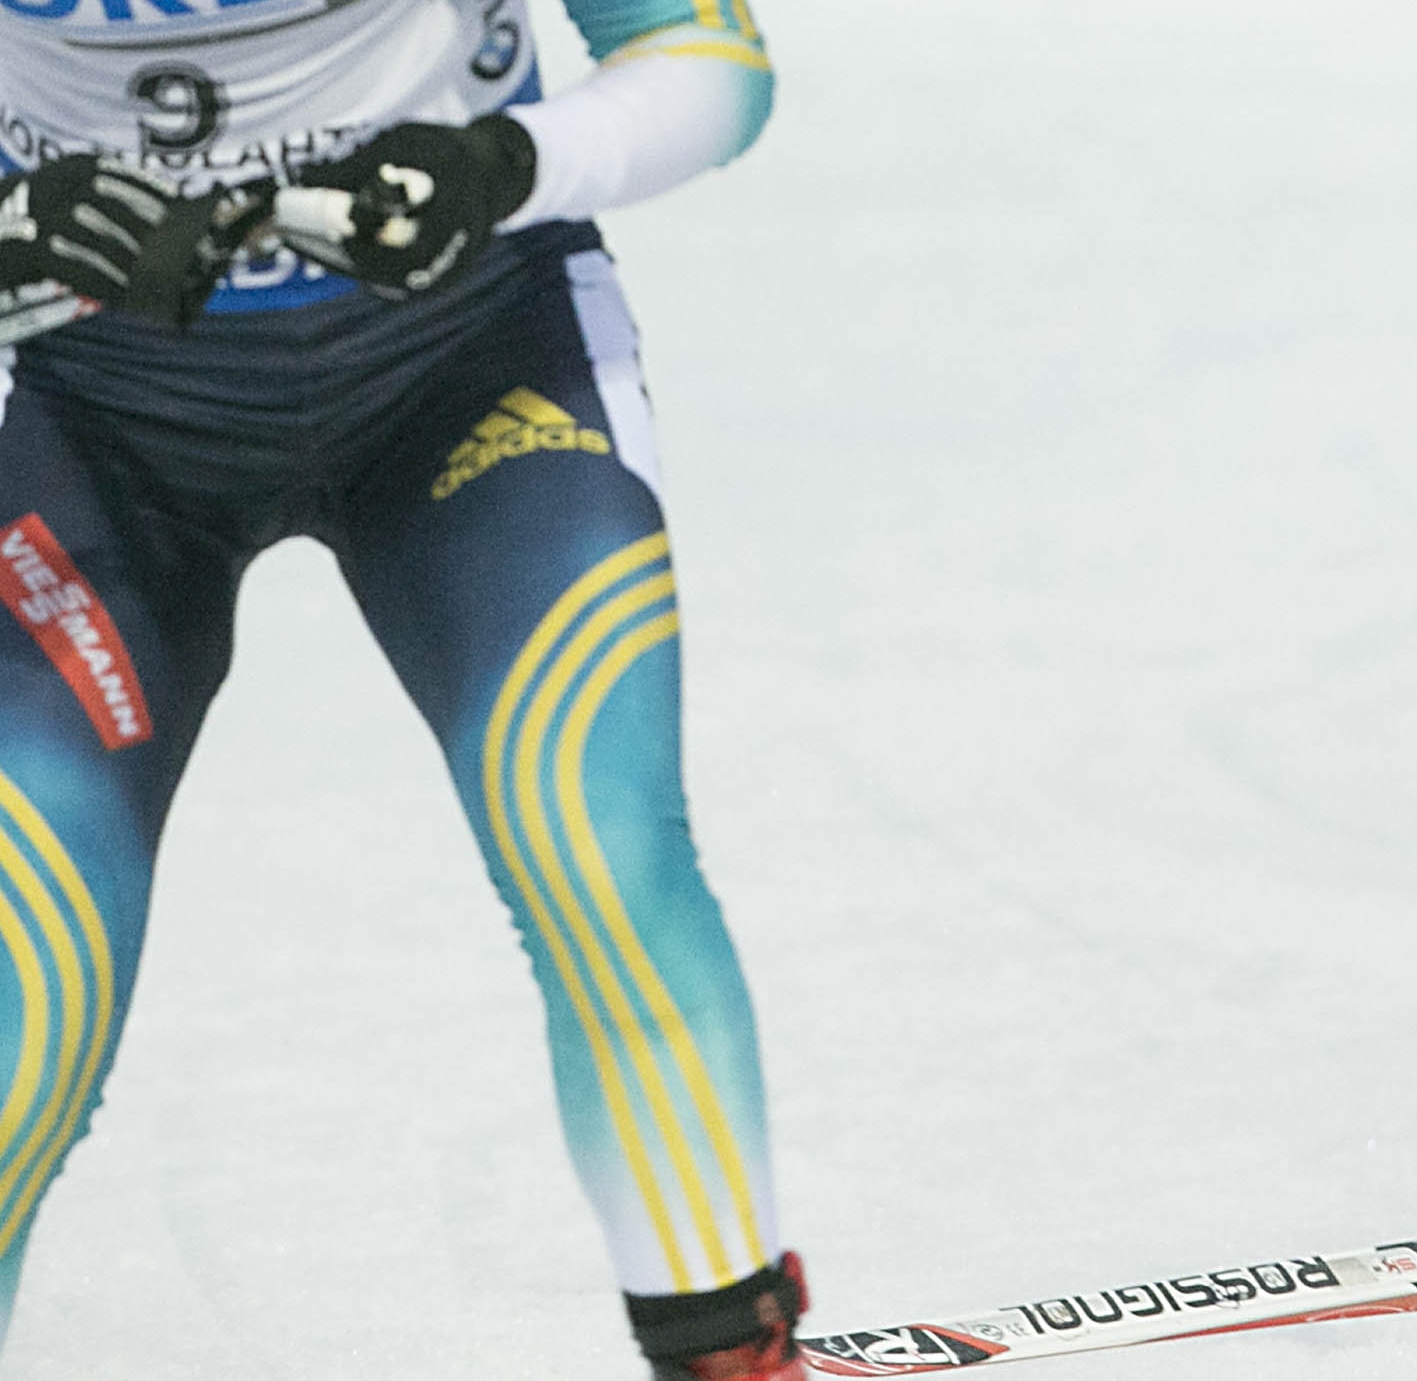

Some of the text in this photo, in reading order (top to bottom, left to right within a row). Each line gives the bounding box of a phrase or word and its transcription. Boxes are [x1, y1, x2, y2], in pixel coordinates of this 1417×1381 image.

[128, 59, 231, 151] 9
[1, 529, 141, 737] VIESSMANN
[1000, 1254, 1342, 1336] ROSSIGNOL
